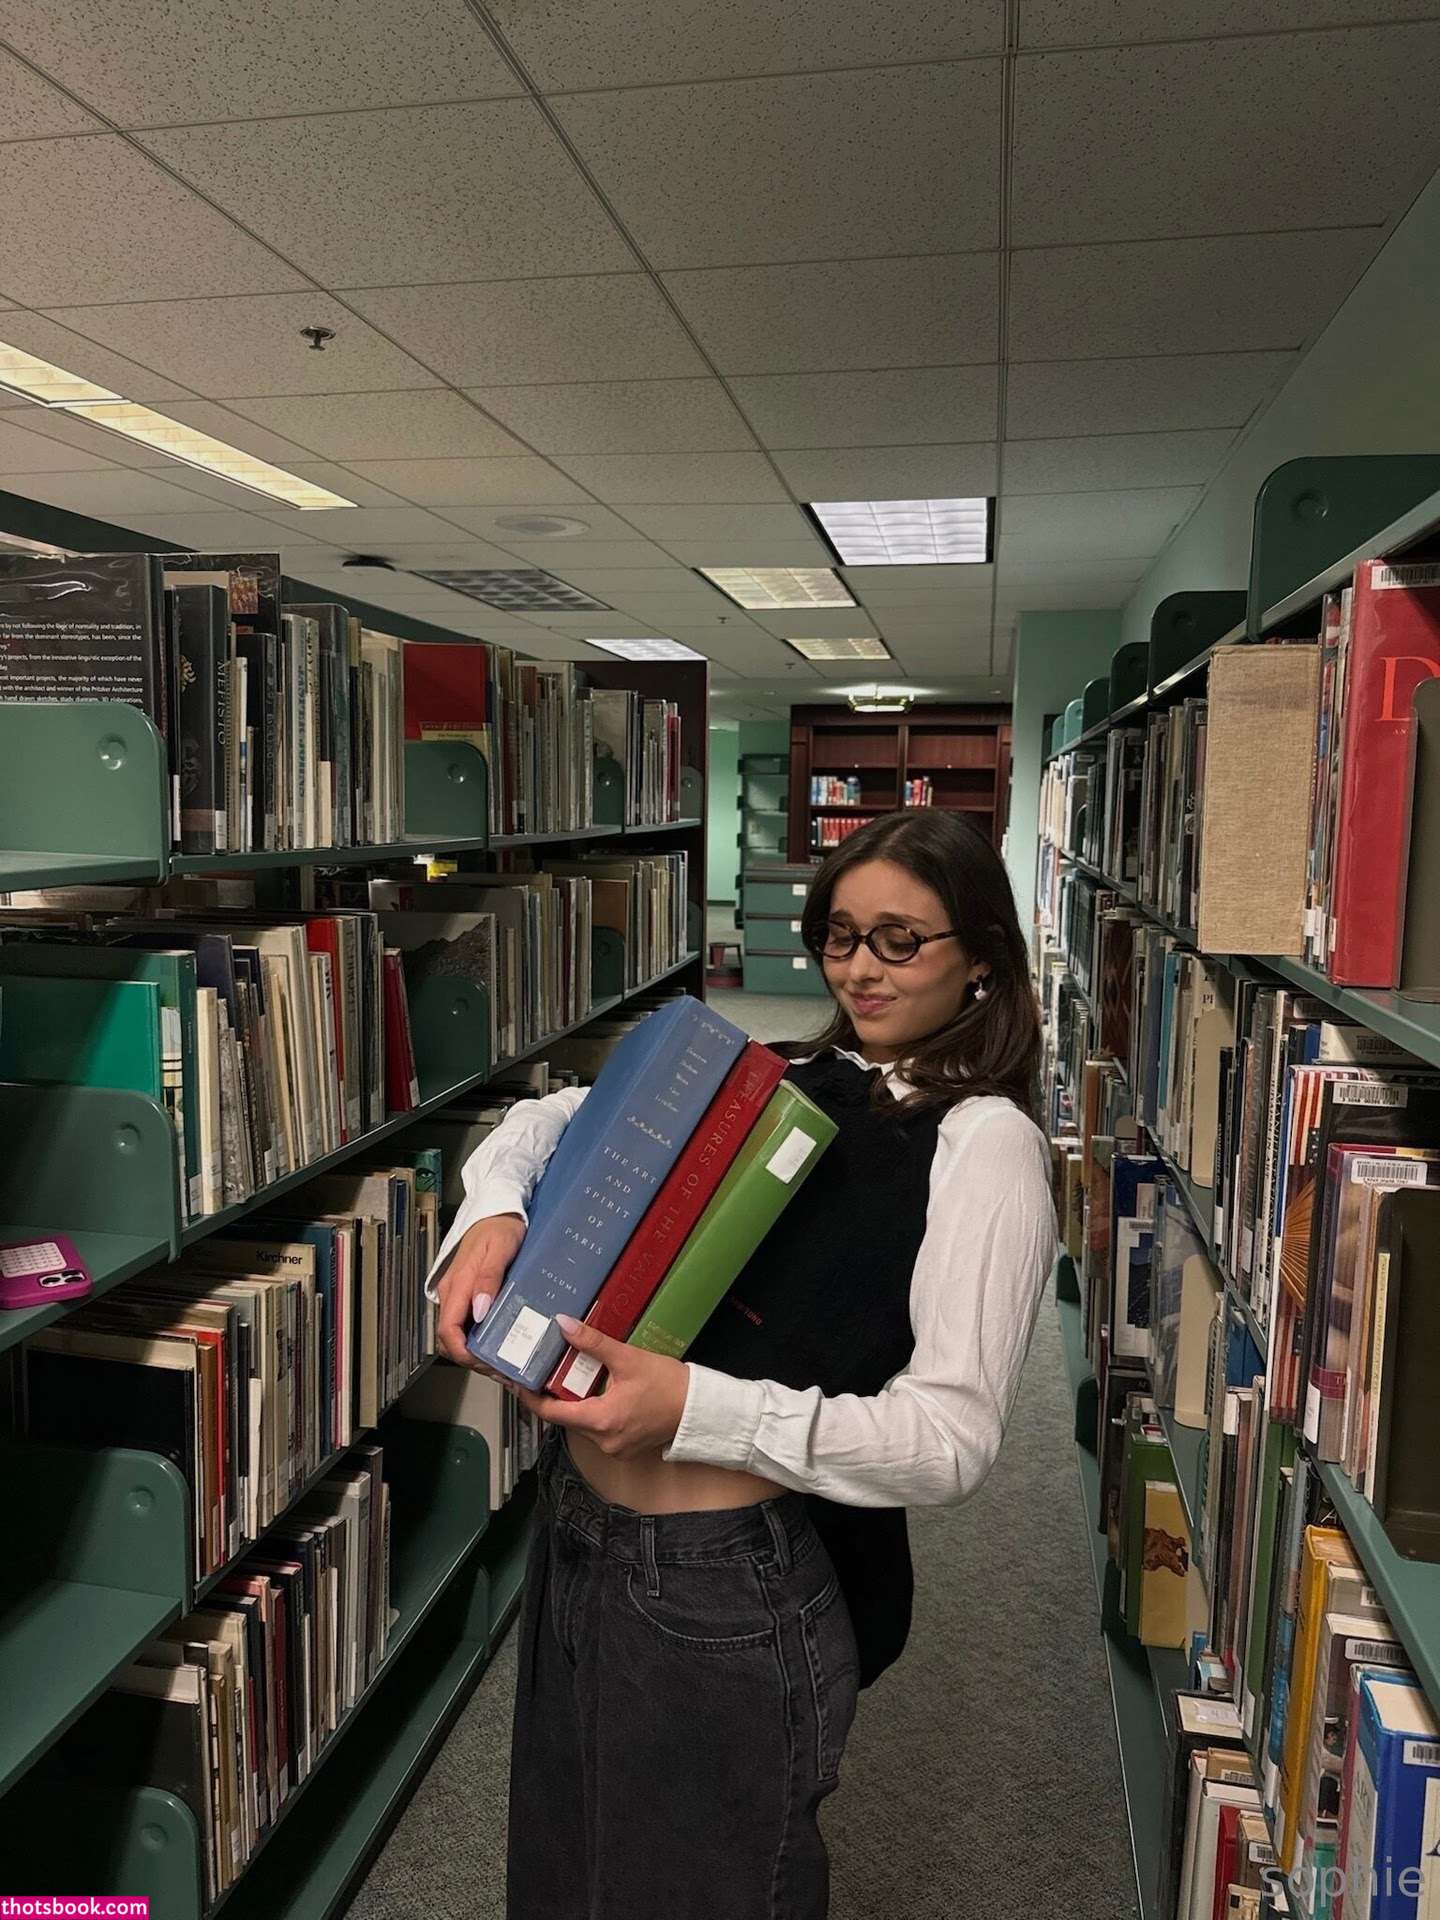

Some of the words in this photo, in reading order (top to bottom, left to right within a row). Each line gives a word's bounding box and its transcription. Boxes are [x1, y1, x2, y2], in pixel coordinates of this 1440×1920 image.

[217, 660, 230, 745] MEFISTO
[699, 1071, 760, 1166] TREASURES
[604, 1146, 629, 1166] THE
[632, 1166, 657, 1184] ART
[605, 1175, 632, 1194] AND
[679, 1173, 700, 1199] OF
[584, 1186, 631, 1219] SPIRIT
[588, 1215, 604, 1229] OF
[654, 1206, 680, 1243] THE
[564, 1227, 603, 1255] PARIS
[256, 1250, 302, 1265] Kirchner
[541, 1268, 577, 1295] VOLUME
